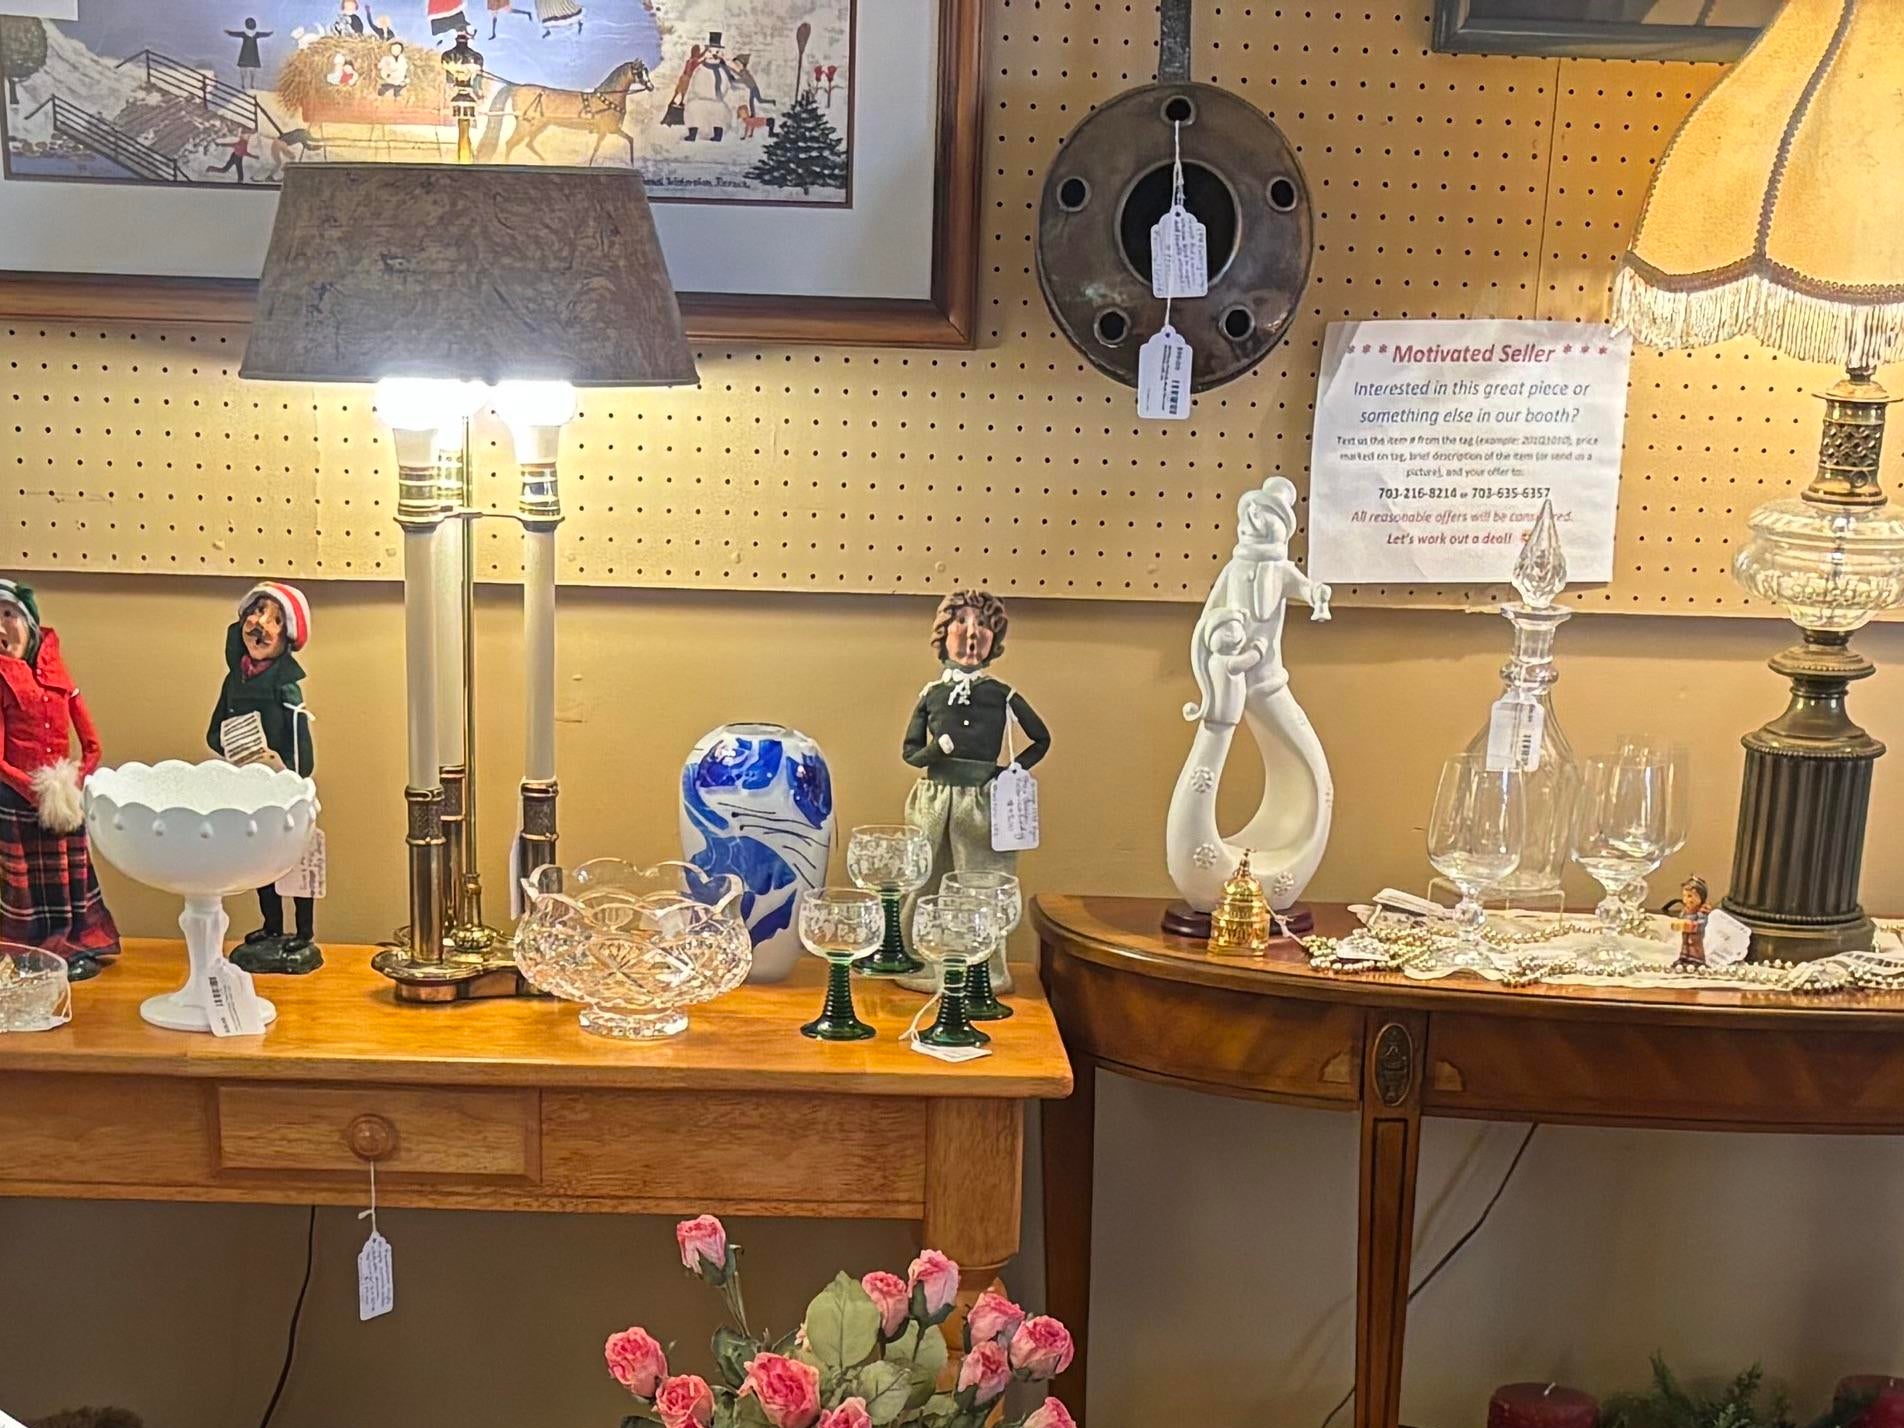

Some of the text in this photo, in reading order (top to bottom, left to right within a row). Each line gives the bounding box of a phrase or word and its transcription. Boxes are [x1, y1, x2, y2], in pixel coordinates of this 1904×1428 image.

[1392, 342, 1556, 363] Motivated Seller
[1354, 380, 1590, 400] Interested in this great piece or
[1360, 407, 1579, 426] something else in our booth?
[1472, 487, 1550, 499] 703-635-6357
[1351, 510, 1367, 522] All
[1369, 512, 1431, 522] reasonable
[1435, 510, 1467, 525] offers
[1493, 510, 1507, 522] be
[1386, 533, 1414, 544] Let's
[1418, 532, 1446, 544] work
[1450, 534, 1469, 545] out
[1472, 536, 1479, 544] a
